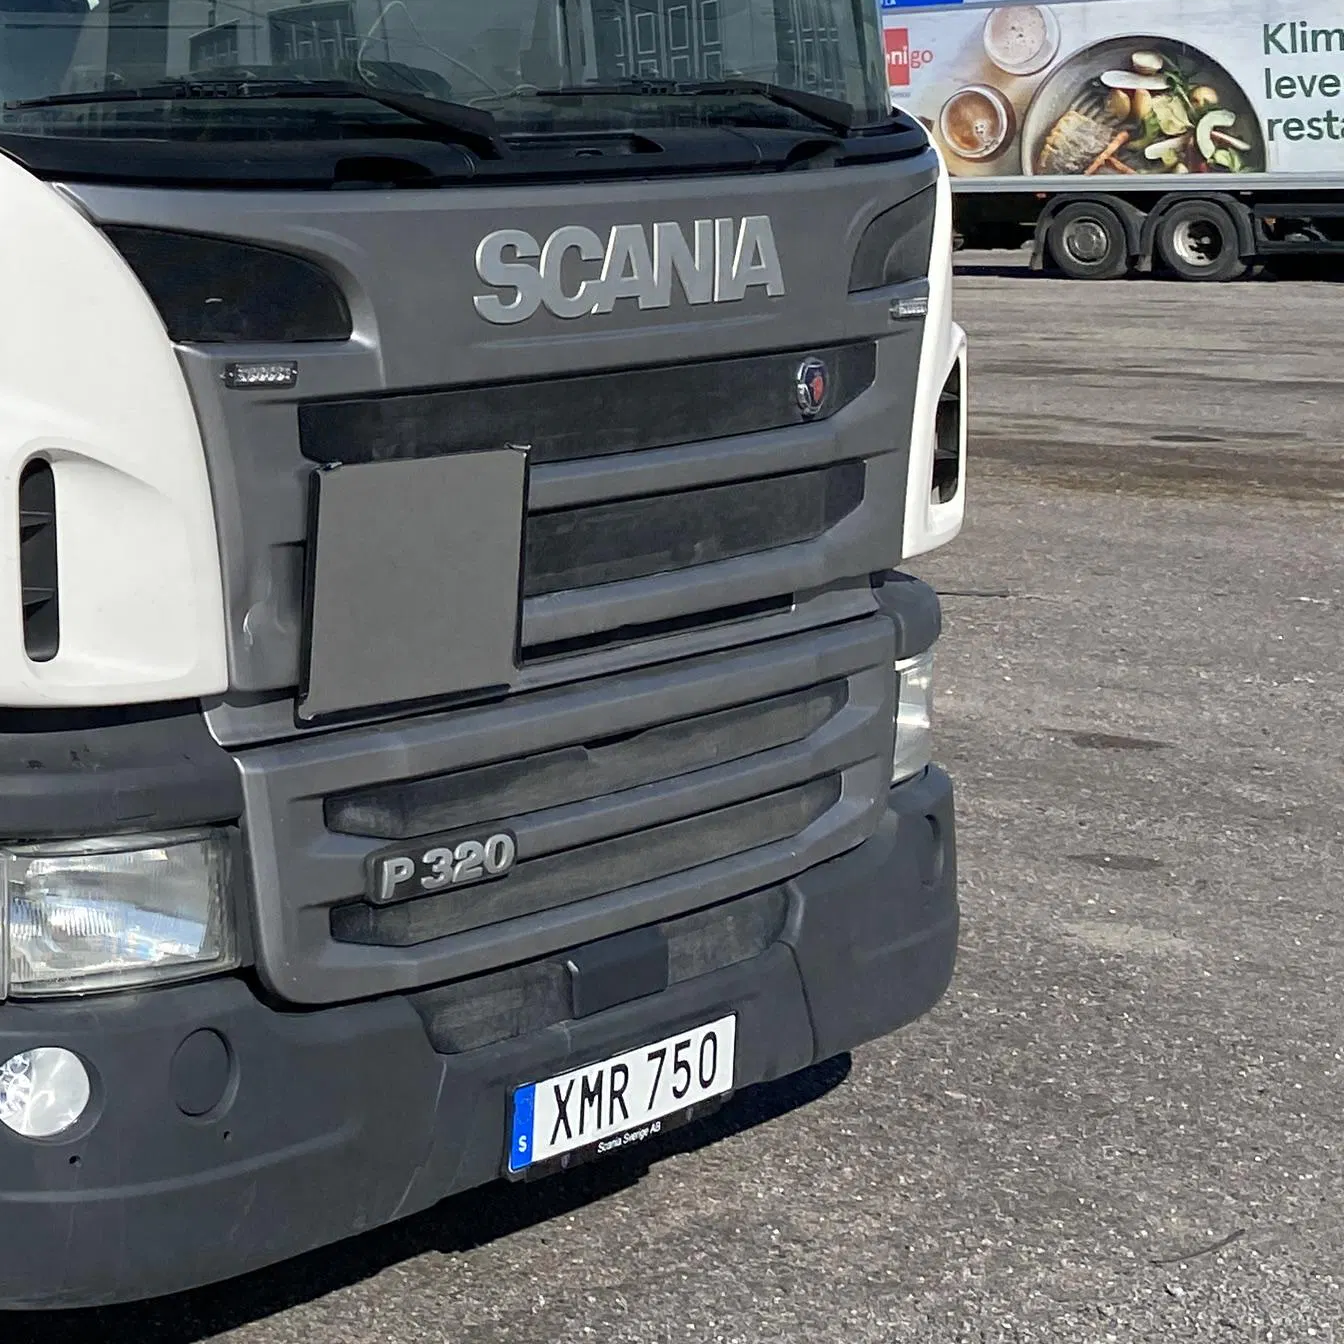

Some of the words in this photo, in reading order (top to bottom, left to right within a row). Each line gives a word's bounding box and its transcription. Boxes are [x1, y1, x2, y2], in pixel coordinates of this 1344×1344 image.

[1263, 21, 1344, 55] Klim
[1265, 67, 1341, 99] leve
[1267, 109, 1344, 142] rest
[473, 215, 785, 324] SCANIA
[381, 856, 415, 899] P
[420, 833, 515, 889] 320
[549, 1063, 629, 1145] XMR
[647, 1031, 718, 1111] 750
[518, 1134, 527, 1153] S
[650, 1121, 661, 1134] AB
